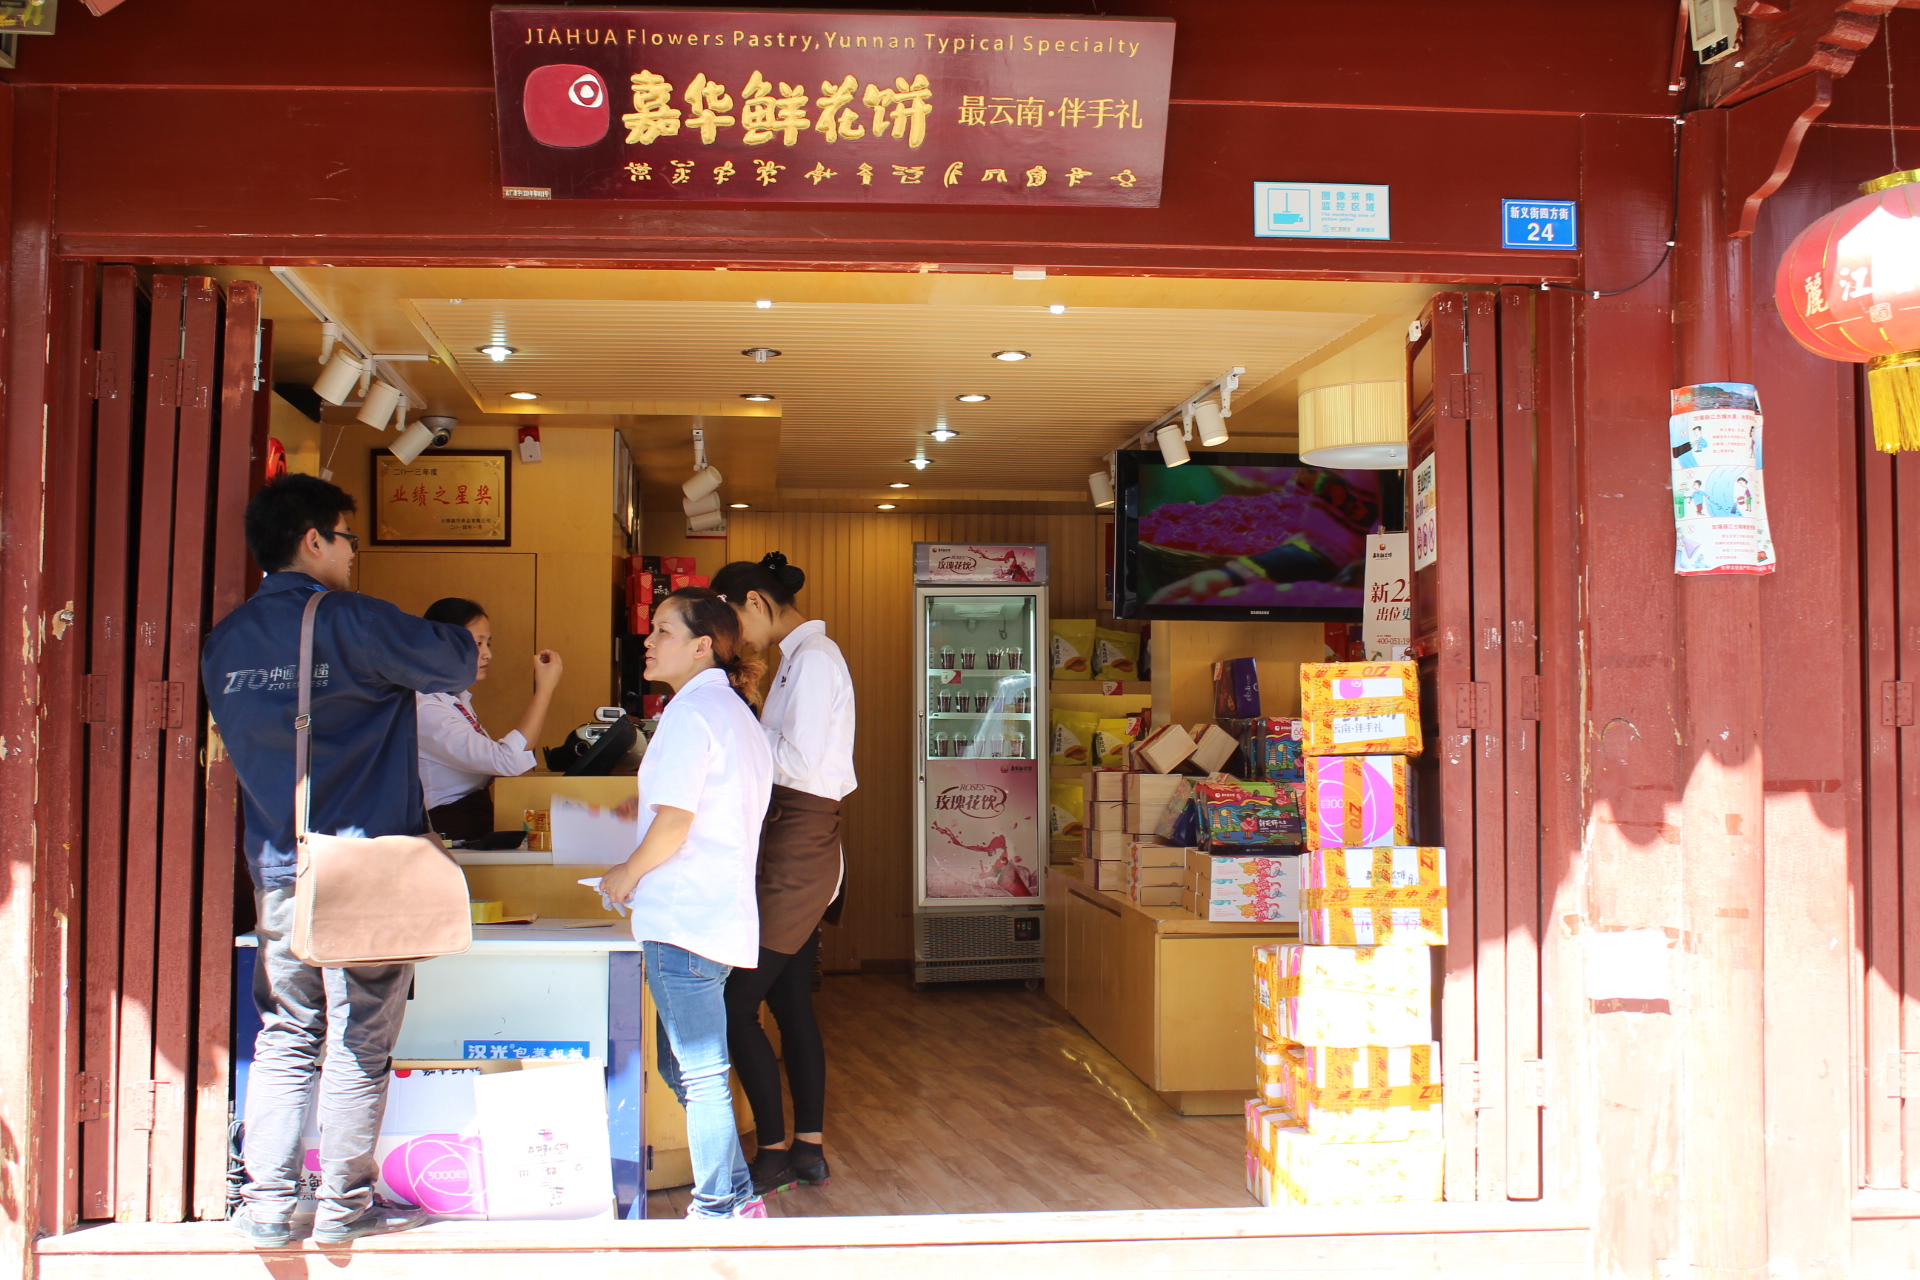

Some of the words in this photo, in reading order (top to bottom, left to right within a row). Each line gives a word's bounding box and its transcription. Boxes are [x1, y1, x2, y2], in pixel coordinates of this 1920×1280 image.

[525, 28, 618, 46] JIAHUA
[627, 28, 724, 47] Flowers
[924, 33, 1015, 54] Typical
[1022, 35, 1140, 58] Specialty
[621, 69, 933, 149] 嘉华鲜花饼
[1321, 201, 1376, 212] 监控区域
[1509, 205, 1569, 221] 新义街四方街
[1527, 222, 1554, 242] 24
[390, 482, 492, 507] 业绩之星奖
[223, 668, 269, 694] ZTO
[269, 663, 330, 682] 中通递
[959, 783, 986, 791] ROSES
[934, 794, 998, 811] 玫瑰花饮
